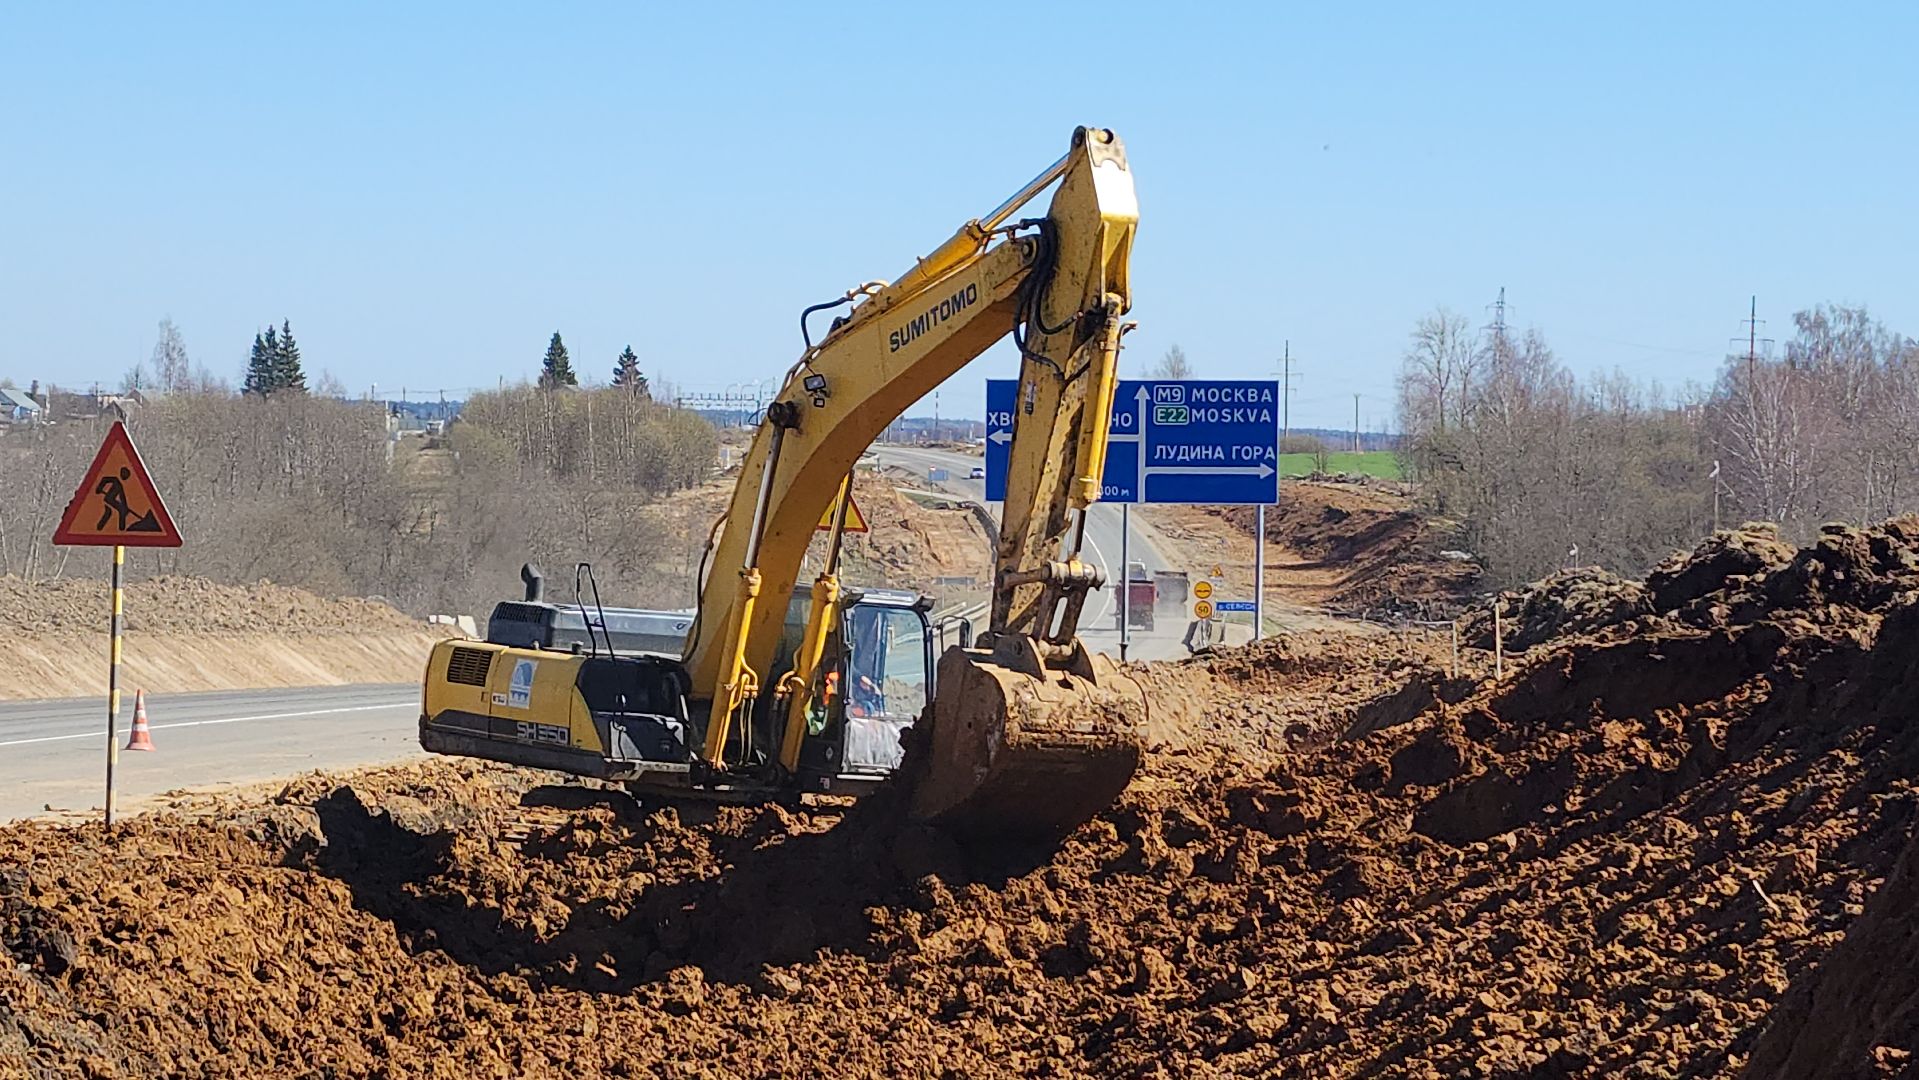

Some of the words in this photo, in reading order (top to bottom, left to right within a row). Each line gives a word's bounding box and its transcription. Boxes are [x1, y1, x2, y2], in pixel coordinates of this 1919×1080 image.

[889, 282, 978, 353] SUMITOMO
[1191, 388, 1273, 403] МОСКВА
[1157, 408, 1188, 423] E22
[1191, 408, 1272, 423] MOSKVA
[1154, 445, 1225, 461] ЛУДИНА
[1231, 445, 1276, 460] ГОРА
[1198, 606, 1209, 614] 50
